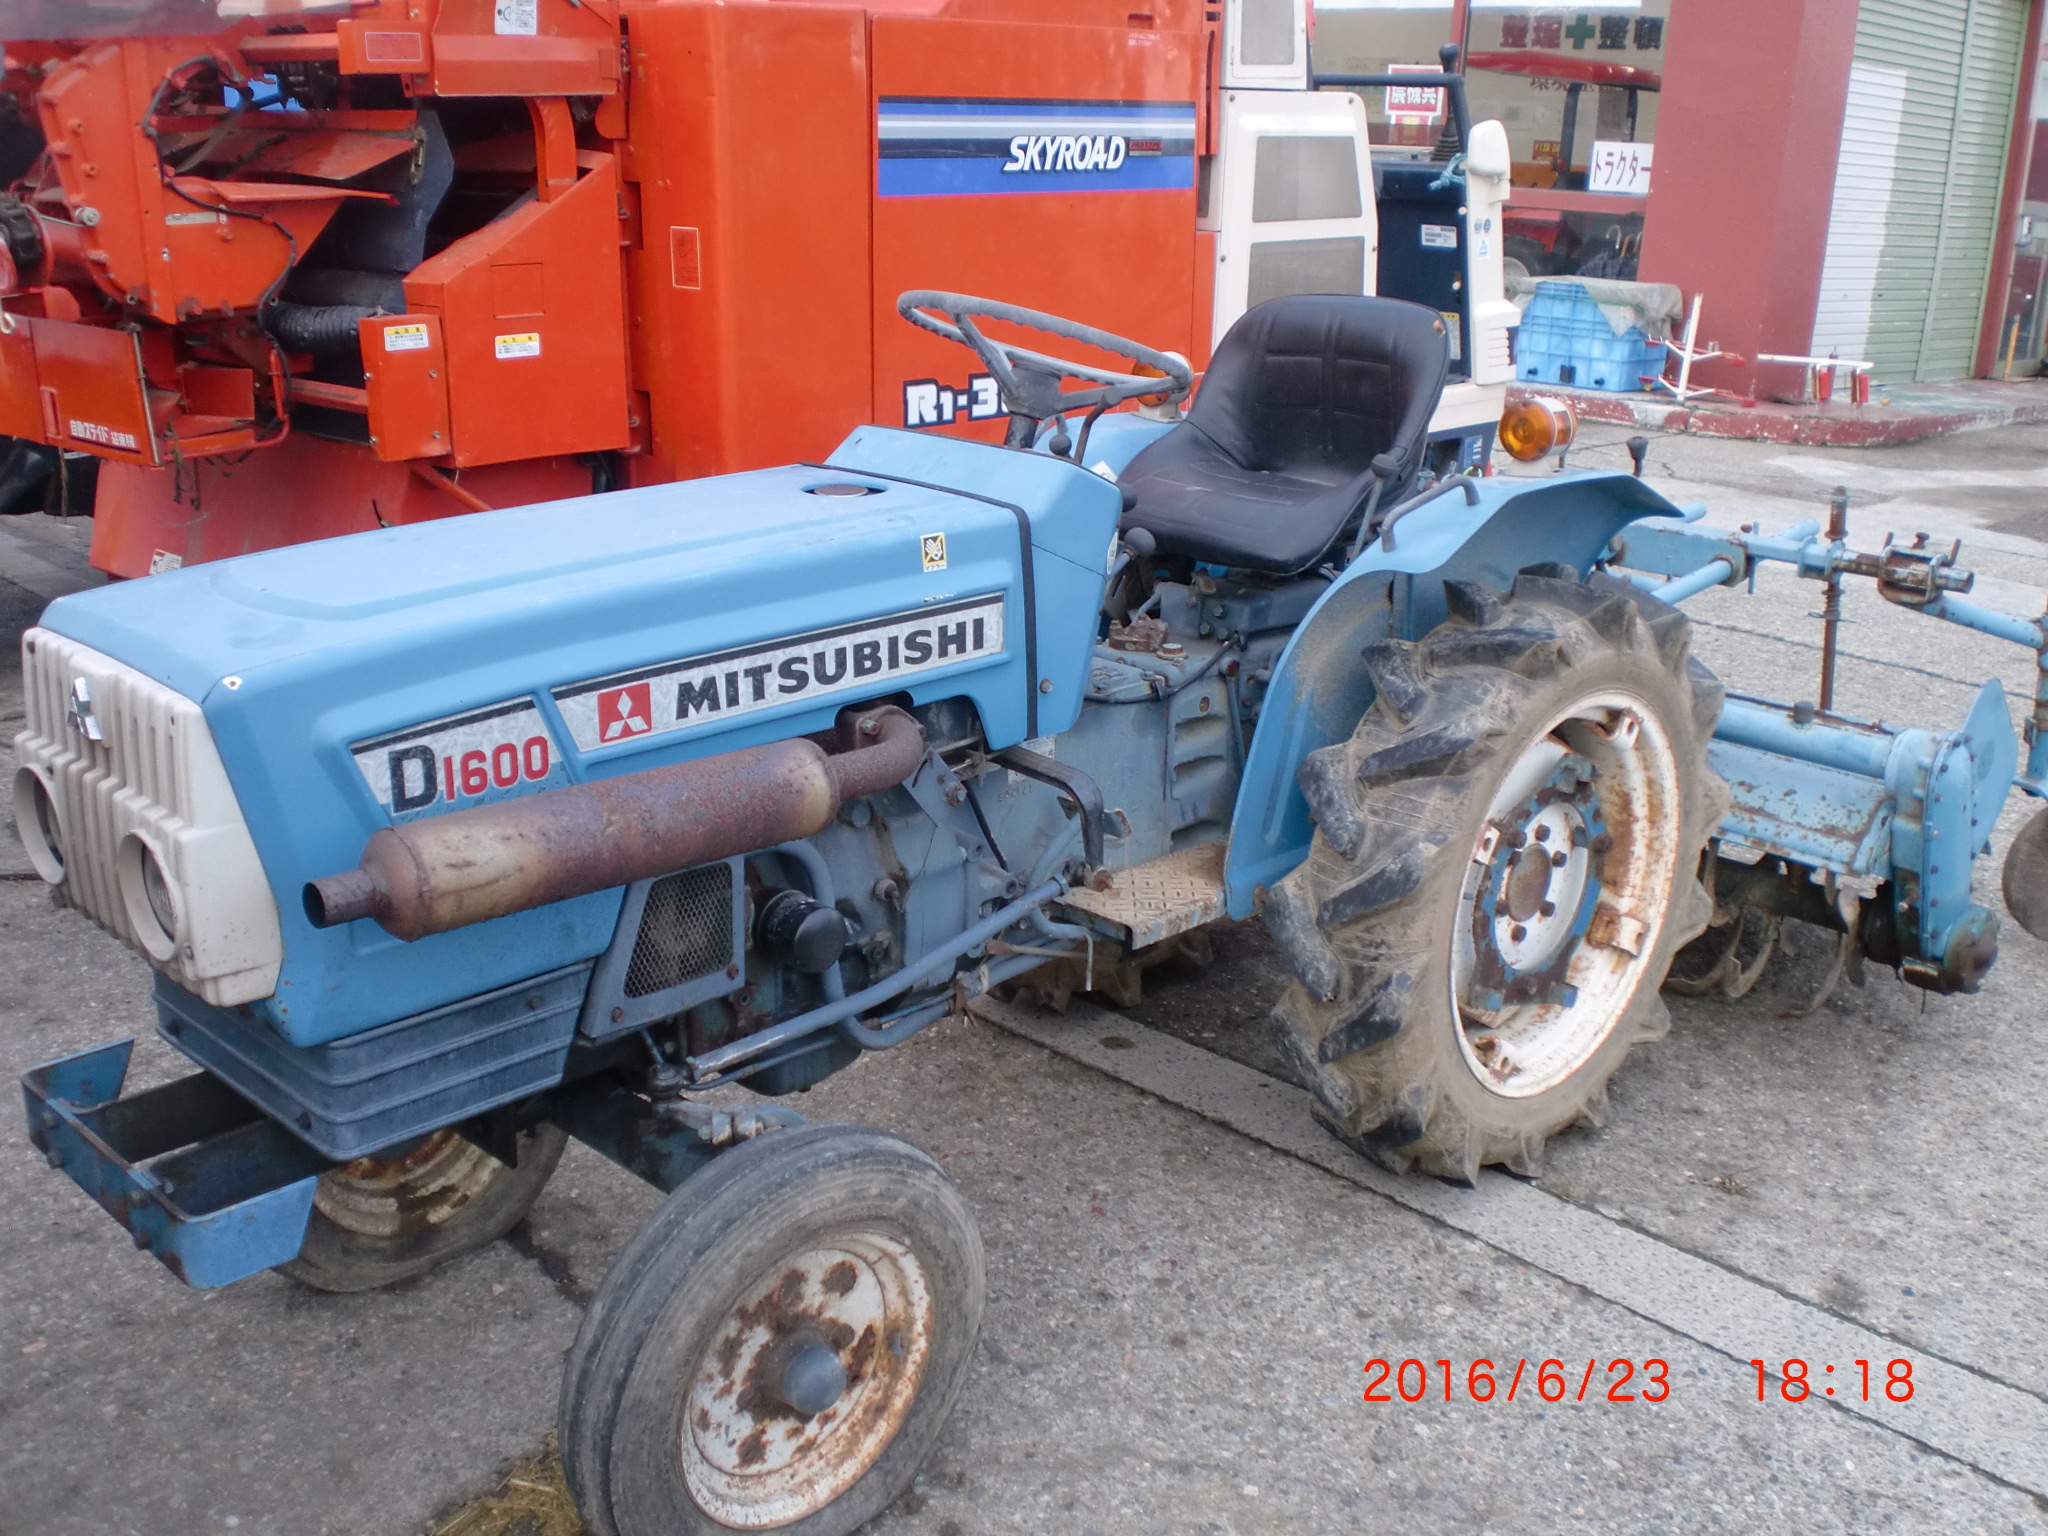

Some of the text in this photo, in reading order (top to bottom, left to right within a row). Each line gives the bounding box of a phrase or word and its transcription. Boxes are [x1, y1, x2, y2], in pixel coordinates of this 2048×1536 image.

[1002, 135, 1126, 173] SKYROAD
[1593, 149, 1652, 186] トラクター
[905, 375, 1009, 427] R1-3
[674, 616, 985, 721] MITSUBISHI
[387, 733, 550, 816] D1600
